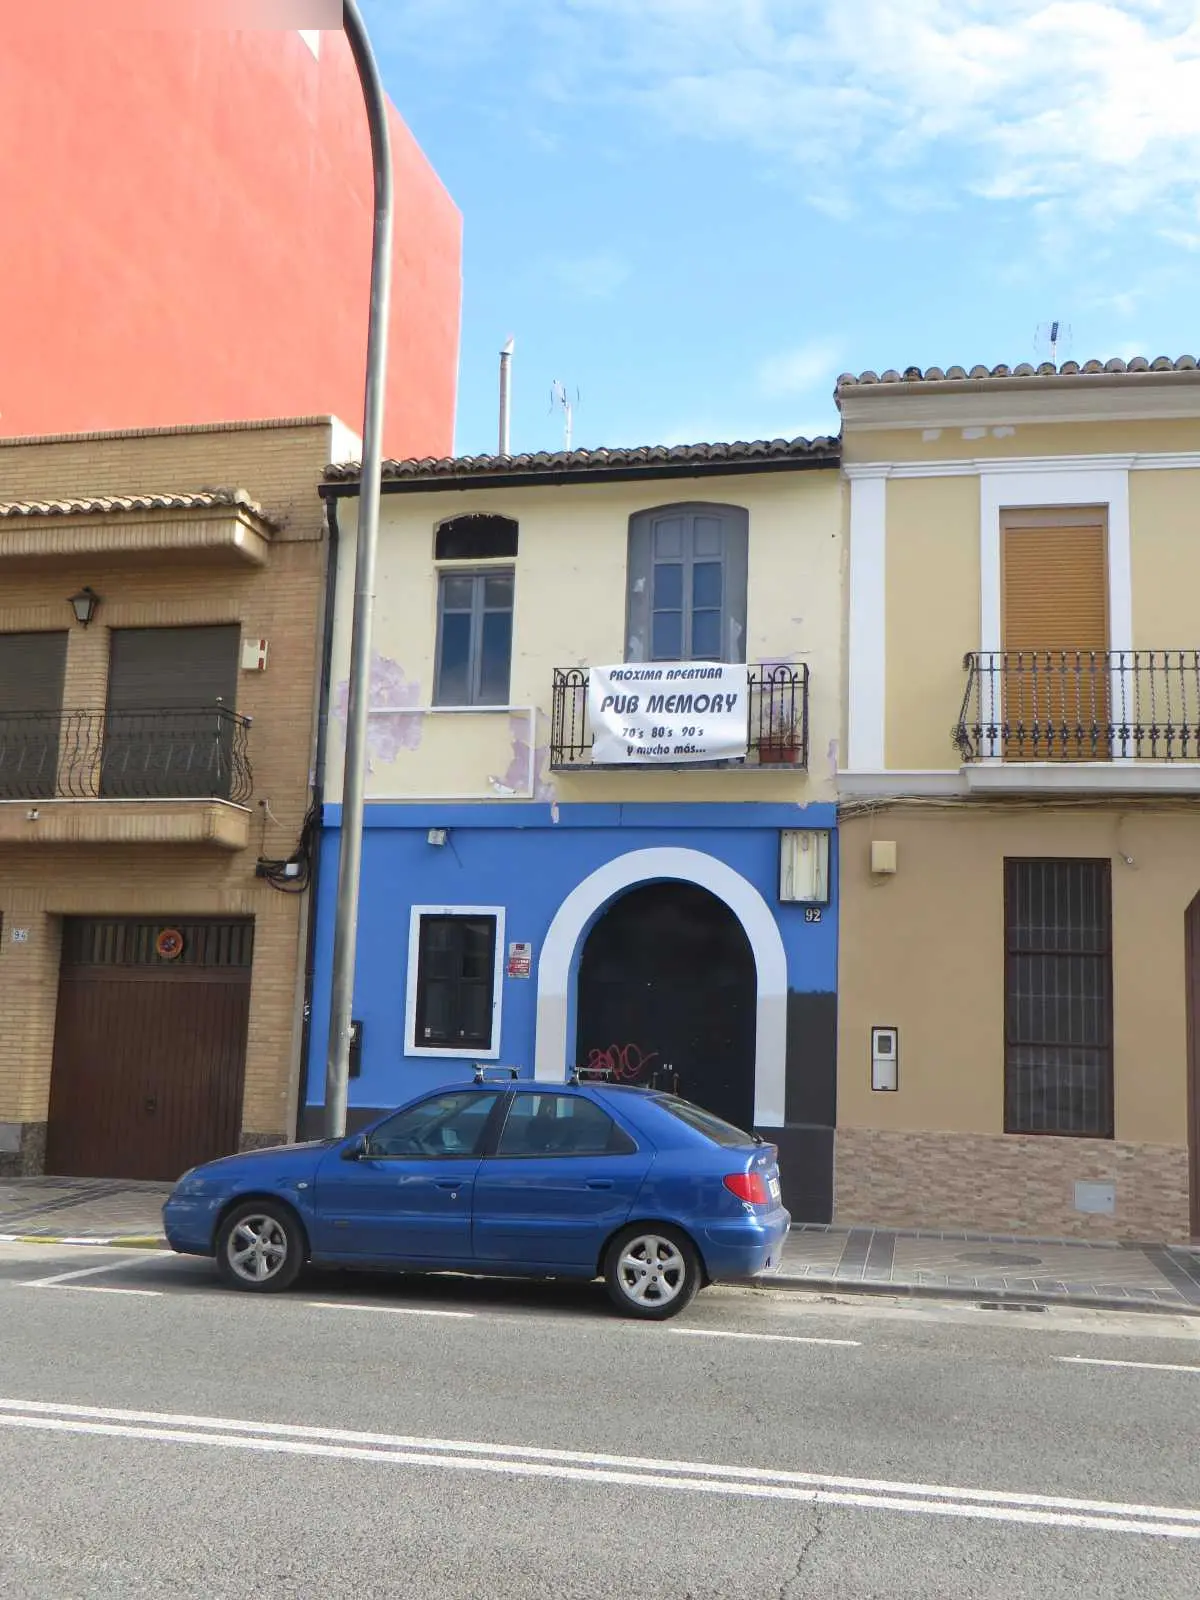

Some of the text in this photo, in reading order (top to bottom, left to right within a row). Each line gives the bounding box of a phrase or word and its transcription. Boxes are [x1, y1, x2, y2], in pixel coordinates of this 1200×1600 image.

[666, 667, 723, 680] APERTURA
[600, 693, 738, 713] PUB MEMORY
[637, 743, 670, 755] mucho
[805, 908, 821, 921] 92
